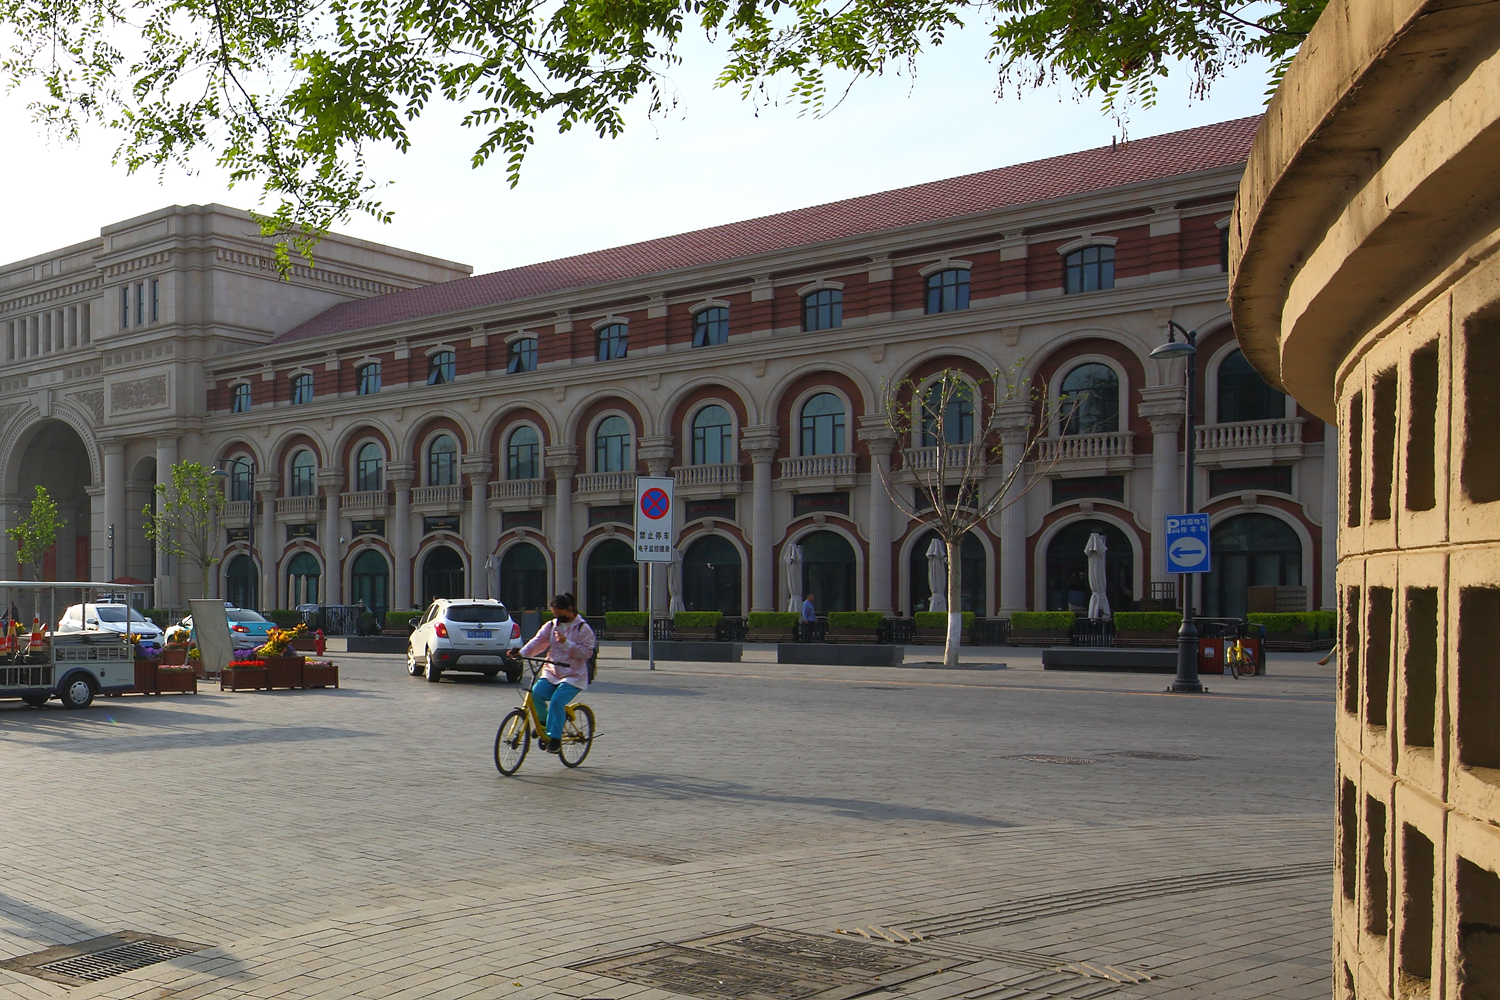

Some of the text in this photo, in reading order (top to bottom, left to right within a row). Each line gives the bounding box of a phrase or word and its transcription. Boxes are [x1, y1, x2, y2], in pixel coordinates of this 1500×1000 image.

[1166, 519, 1179, 534] P
[639, 531, 670, 540] 禁止停车
